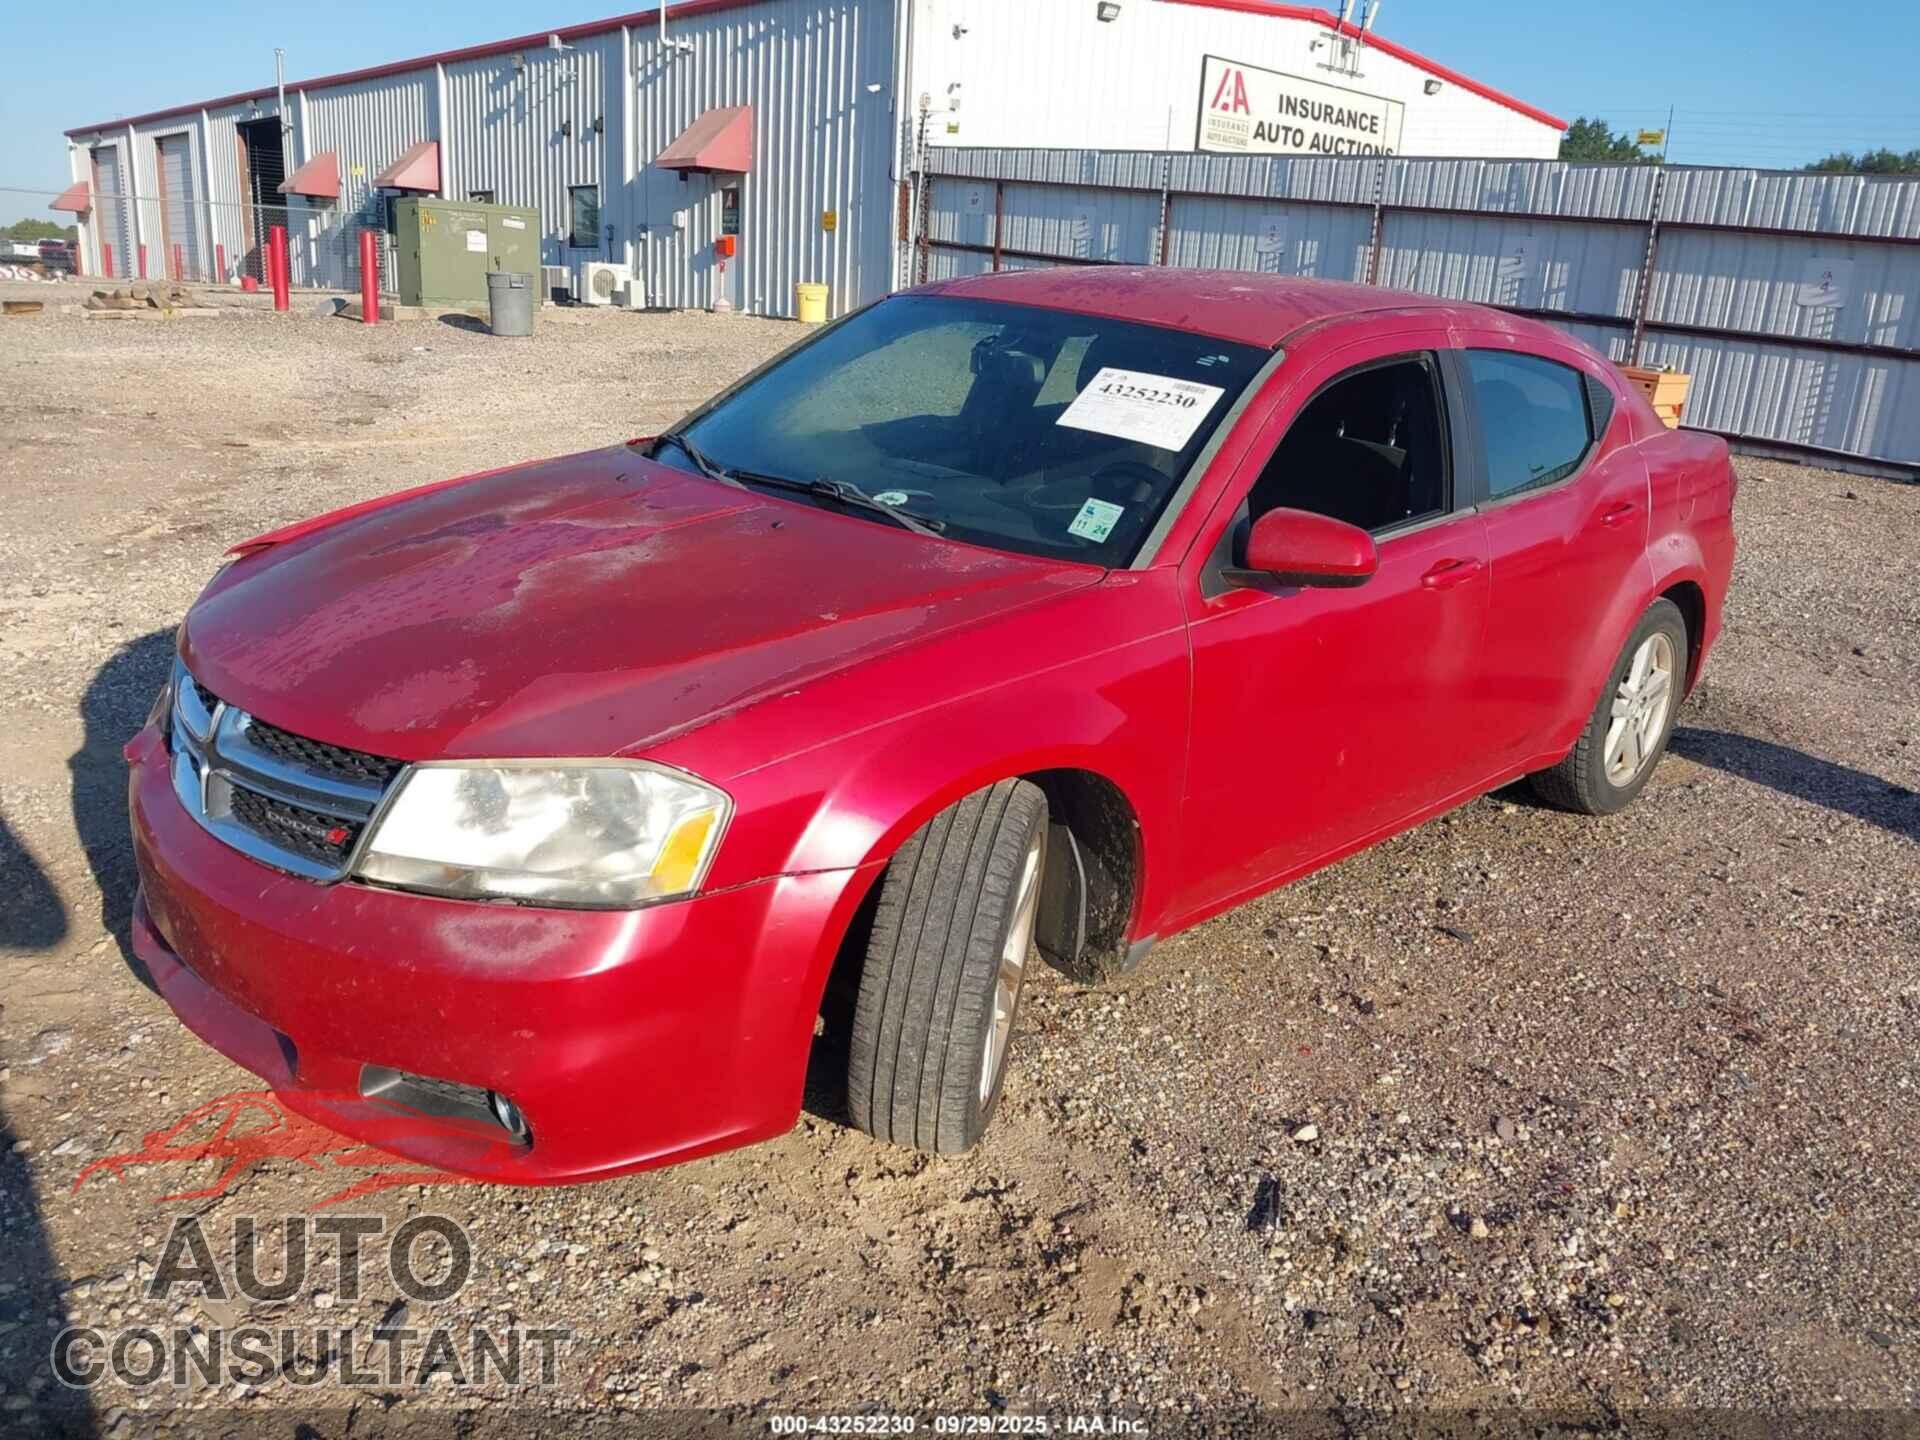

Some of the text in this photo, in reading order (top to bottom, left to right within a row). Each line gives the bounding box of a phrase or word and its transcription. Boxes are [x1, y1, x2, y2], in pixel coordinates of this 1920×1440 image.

[1279, 94, 1379, 134] INSURANCE
[1253, 121, 1304, 148] AUTO
[1099, 383, 1196, 409] 43252230
[266, 811, 326, 838] DODGE
